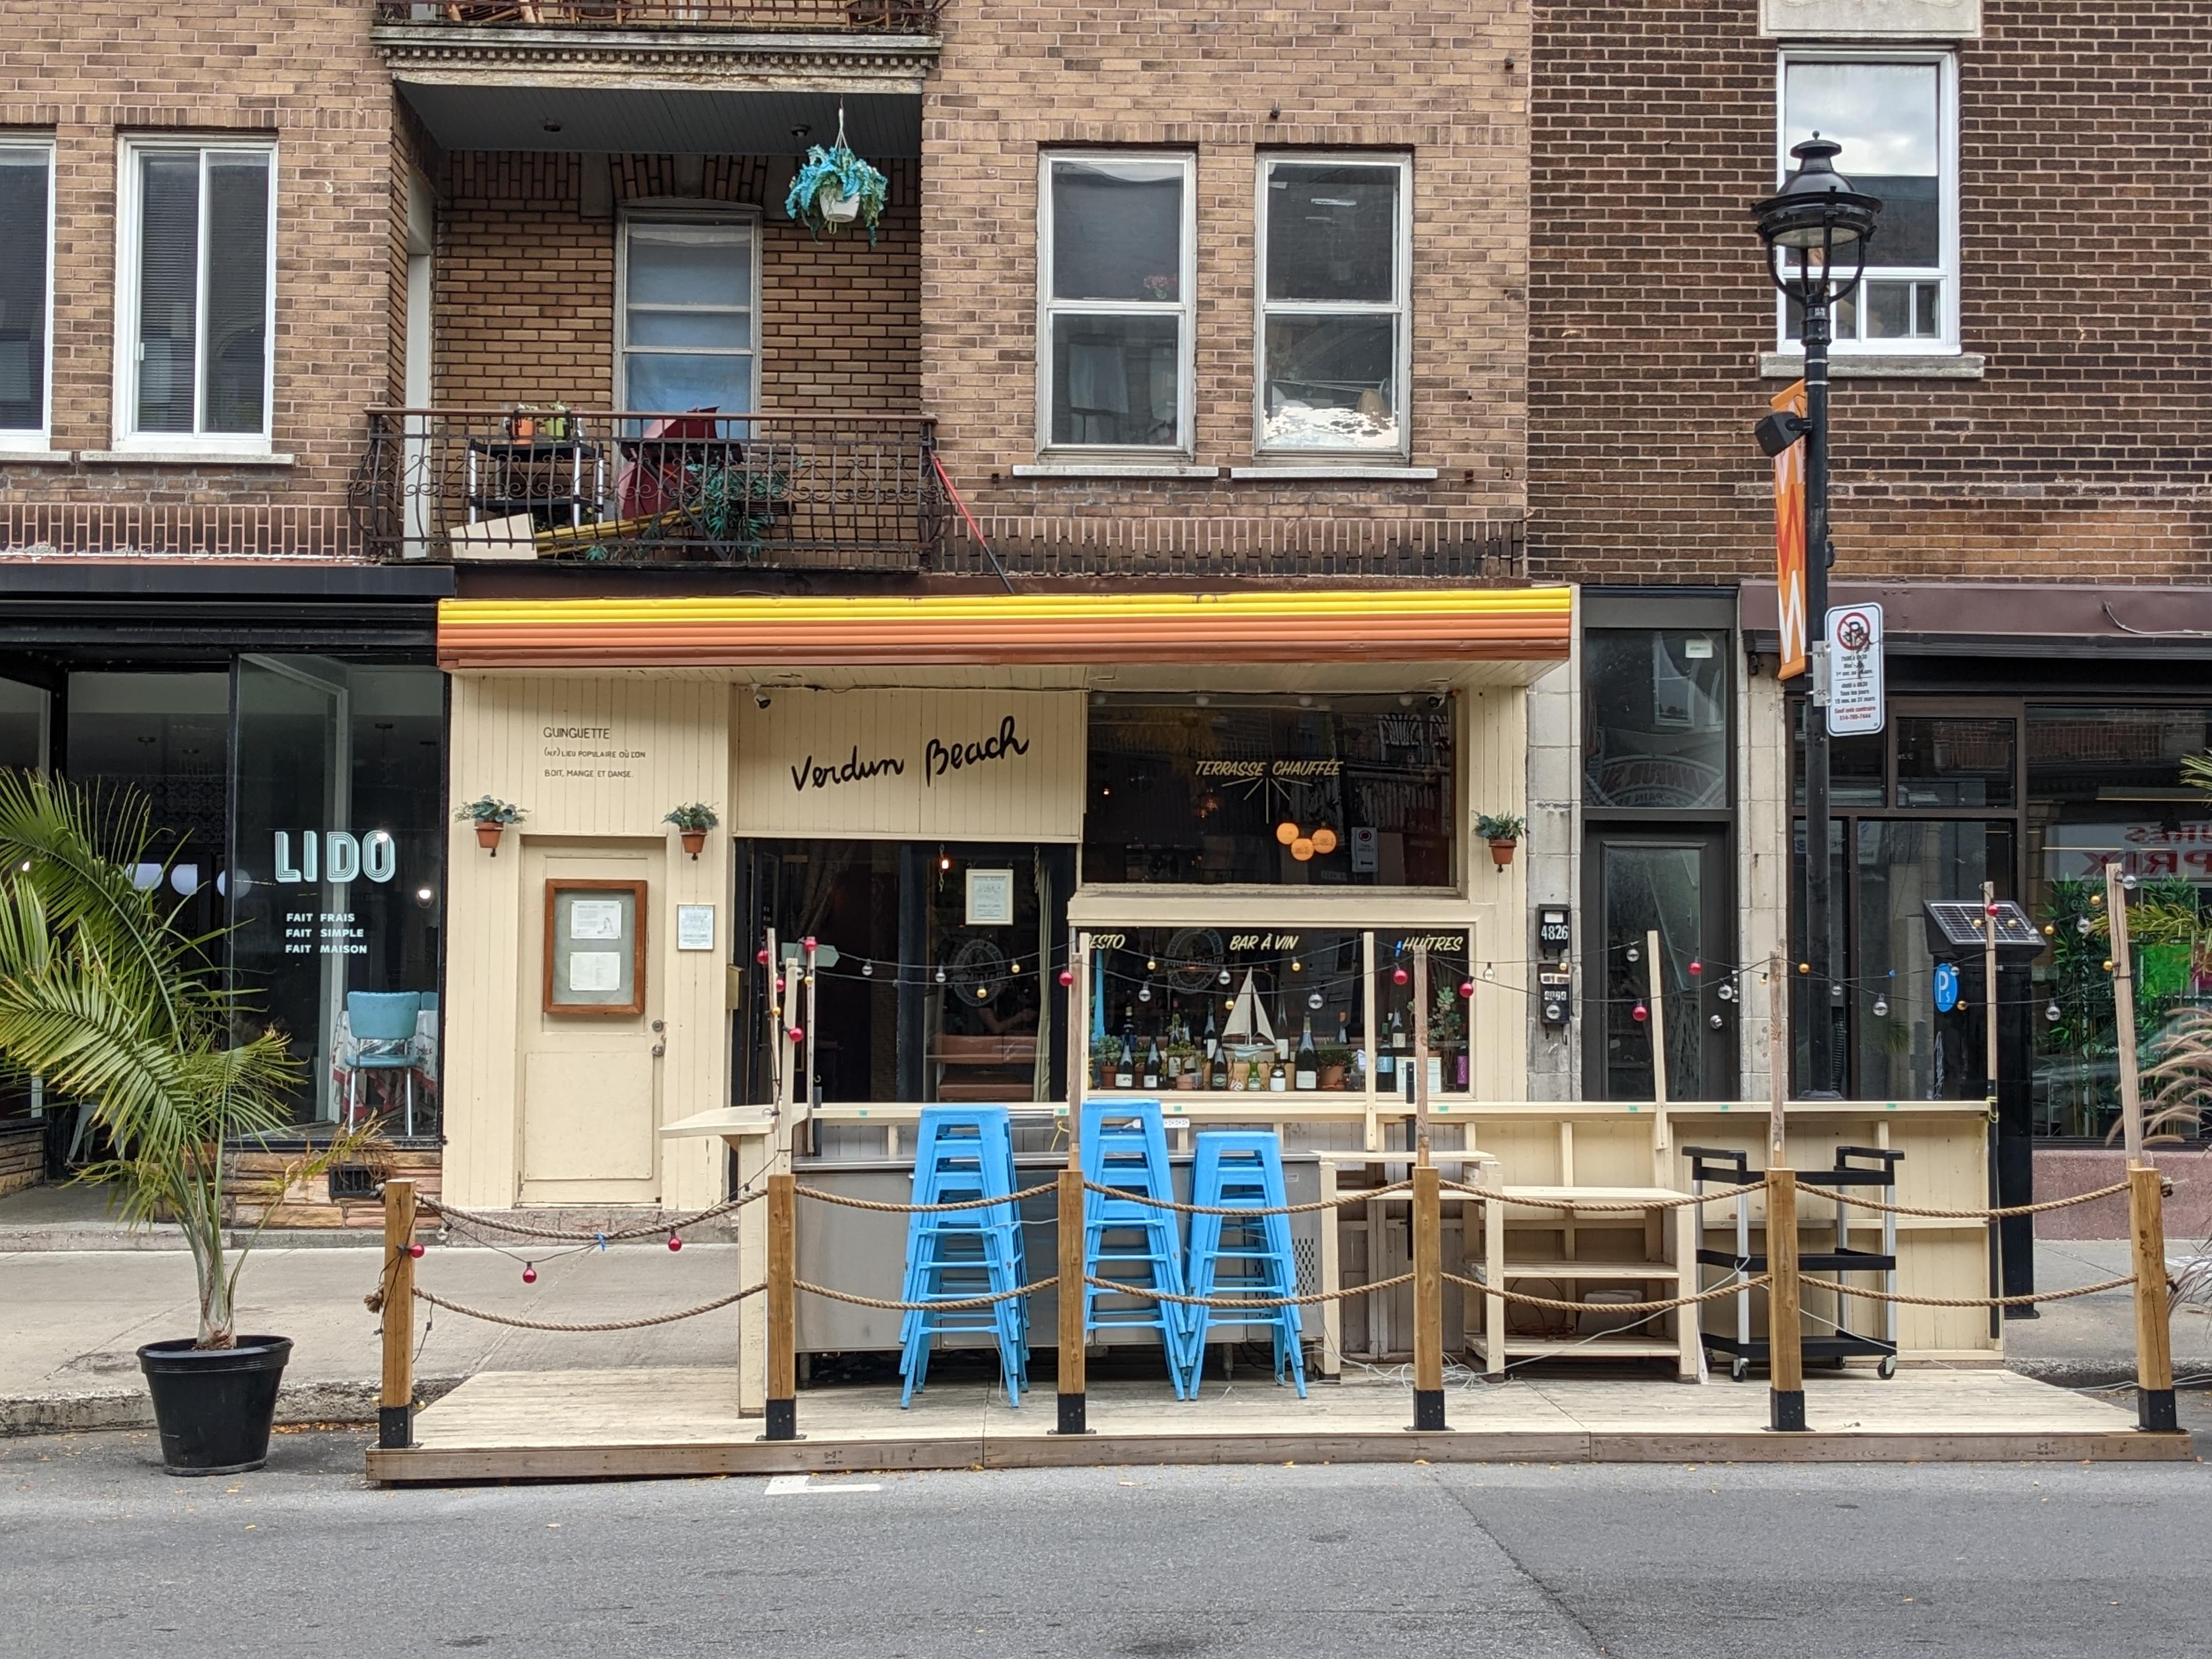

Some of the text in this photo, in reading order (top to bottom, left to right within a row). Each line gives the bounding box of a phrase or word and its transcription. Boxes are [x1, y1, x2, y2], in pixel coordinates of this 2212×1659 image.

[543, 727, 610, 740] GUINGUETTE
[619, 749, 629, 758] OÙ
[791, 715, 1029, 791] Verdun Beach
[544, 769, 565, 777] BOIT,
[1195, 758, 1344, 776] TERRASSE CHAUFFÉE
[275, 830, 396, 883] LIDO
[286, 913, 355, 922] FAIT FRAIS
[286, 929, 364, 938] FAIT SIMPLE
[1541, 925, 1569, 940] 4826
[1229, 933, 1300, 951] BAR À VIN
[1402, 934, 1464, 951] HUÎTRES
[285, 945, 368, 954] FAIT MAISON
